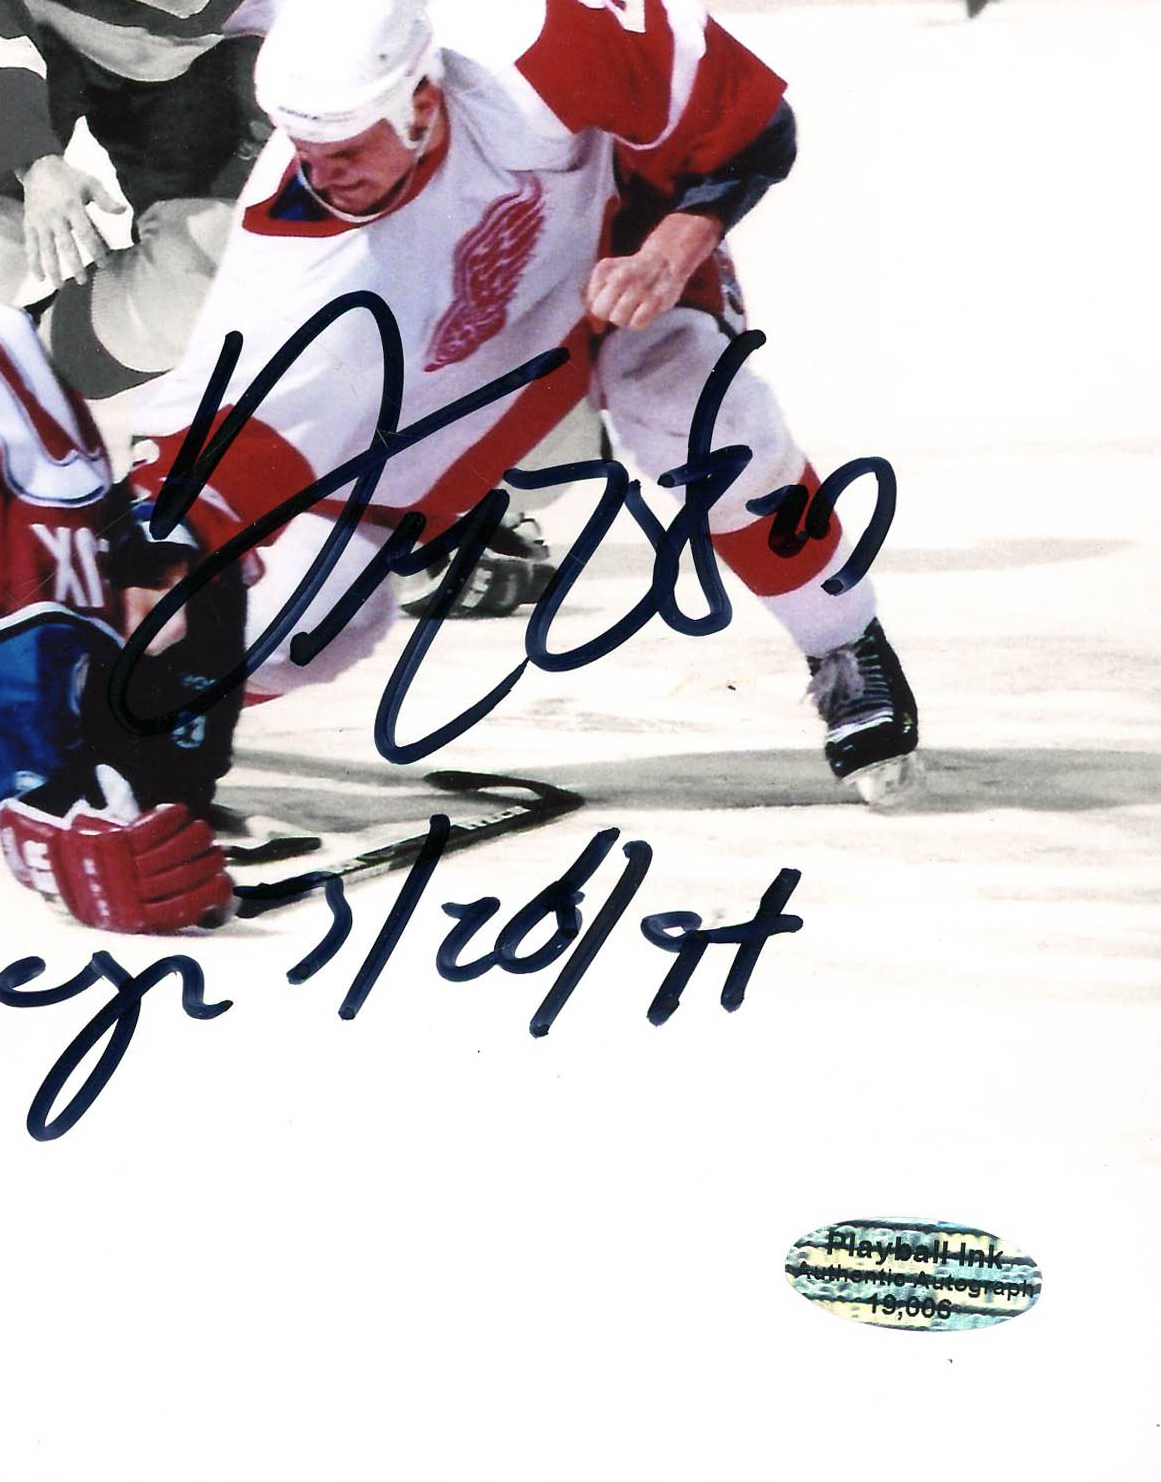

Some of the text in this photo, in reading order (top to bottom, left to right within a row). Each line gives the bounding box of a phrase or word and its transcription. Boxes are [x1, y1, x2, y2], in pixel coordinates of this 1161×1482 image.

[826, 1230, 1004, 1269] Playball Ink
[913, 1271, 1035, 1301] Autograph
